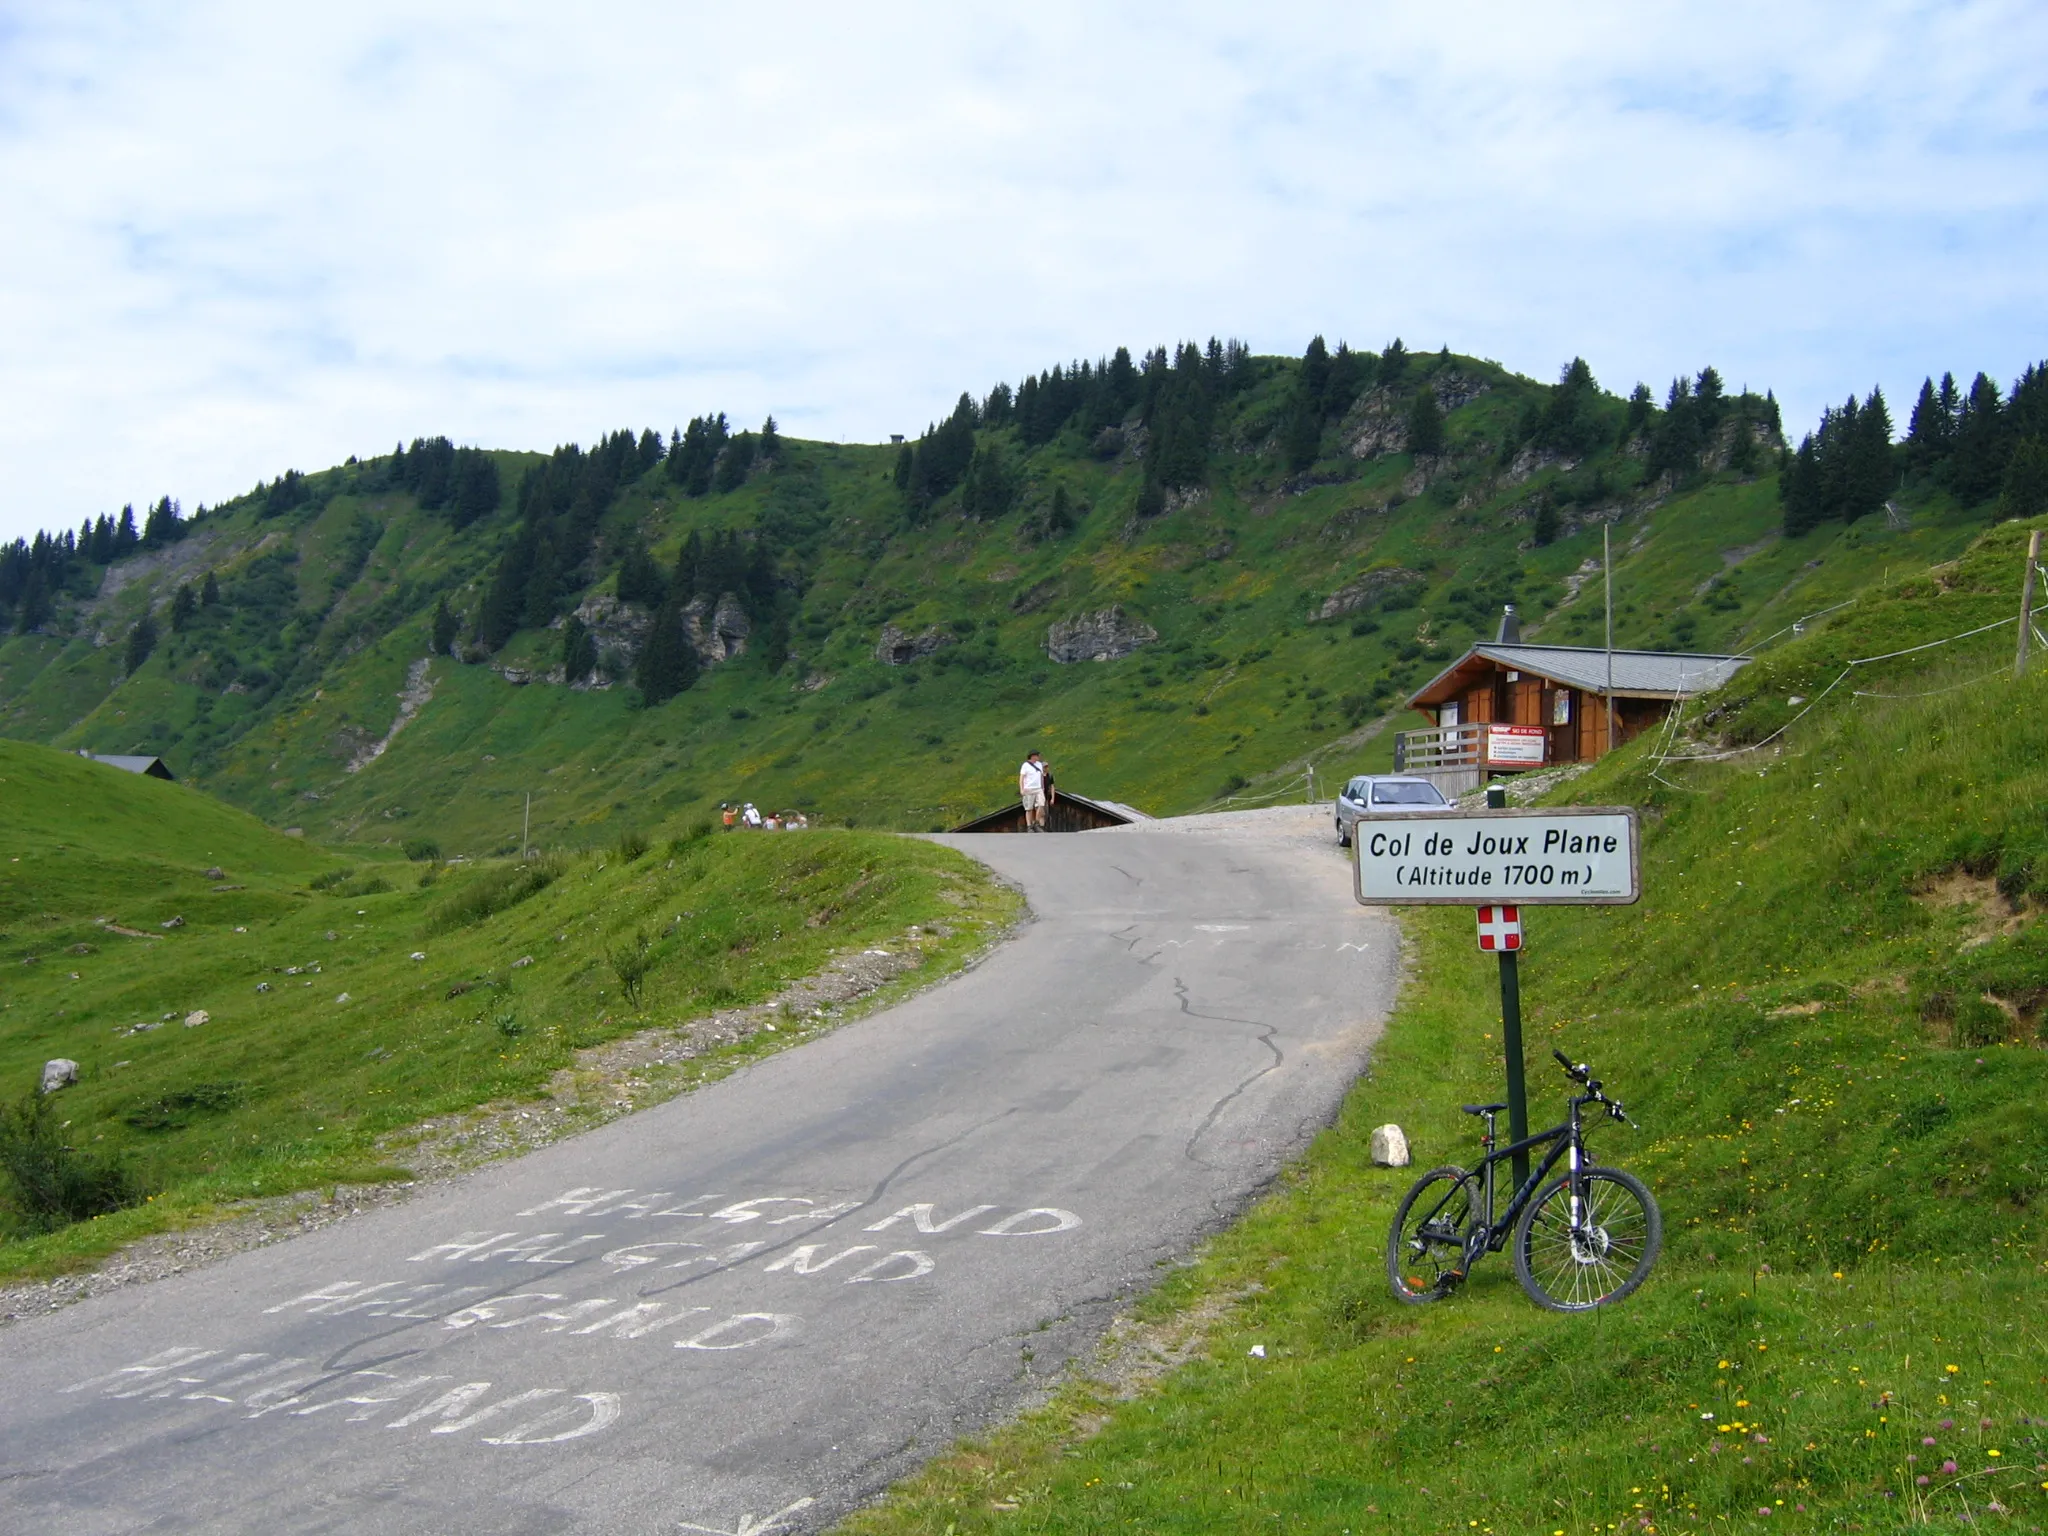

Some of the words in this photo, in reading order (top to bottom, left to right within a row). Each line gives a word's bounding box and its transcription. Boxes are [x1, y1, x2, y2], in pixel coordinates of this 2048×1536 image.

[1370, 832, 1411, 857] Col
[1424, 831, 1454, 856] de
[1466, 831, 1529, 855] Joux
[1543, 829, 1618, 854] Plane
[1396, 865, 1492, 886] (Altitude
[1504, 864, 1554, 885] 1700
[1560, 864, 1593, 885] m)
[515, 1187, 1084, 1236] HALGAND
[406, 1230, 937, 1285] HALGAND
[262, 1280, 805, 1350] HALGAND
